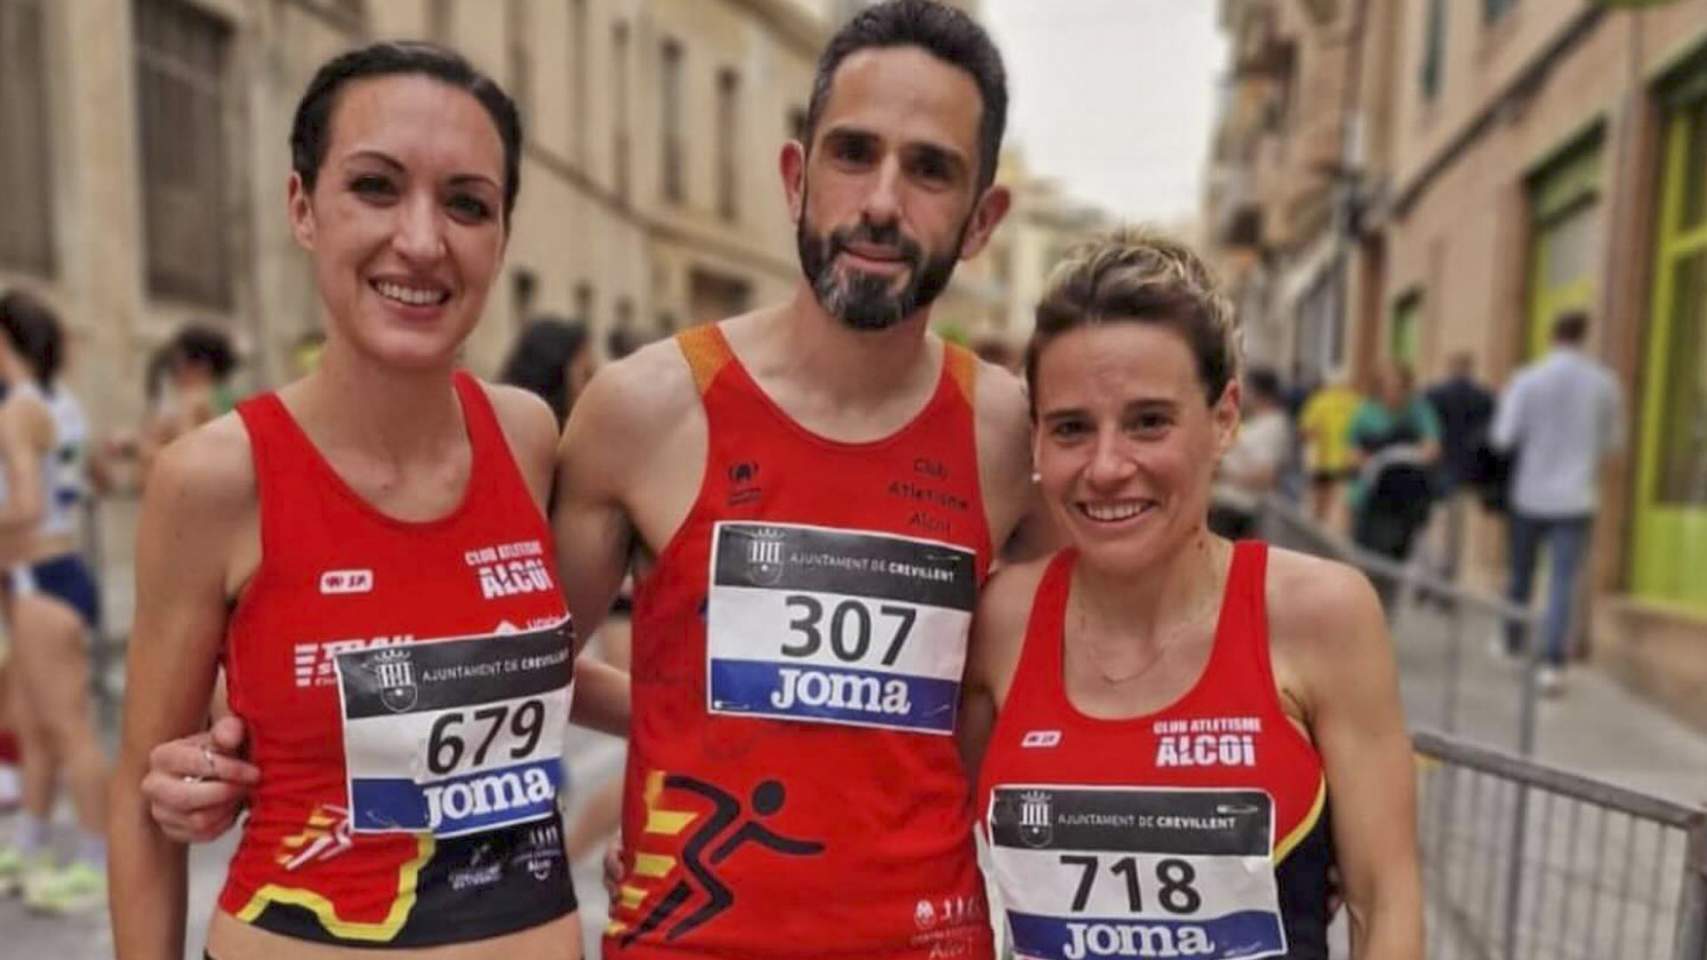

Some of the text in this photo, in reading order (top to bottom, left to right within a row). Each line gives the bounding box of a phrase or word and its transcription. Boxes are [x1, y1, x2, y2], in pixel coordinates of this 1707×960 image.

[479, 558, 554, 599] ALCOI
[790, 552, 954, 582] AJUNTAMENT DE CREVILLENT
[781, 595, 917, 667] 307
[422, 661, 501, 682] AJUNTAMENT
[504, 659, 519, 672] DE
[427, 700, 546, 775] 679
[1153, 717, 1262, 734] CLUB ATLETISME
[1156, 734, 1256, 766] ALCOI
[1058, 813, 1236, 830] AJUNTAMENT DE CREVILLENT
[1060, 855, 1201, 914] 718
